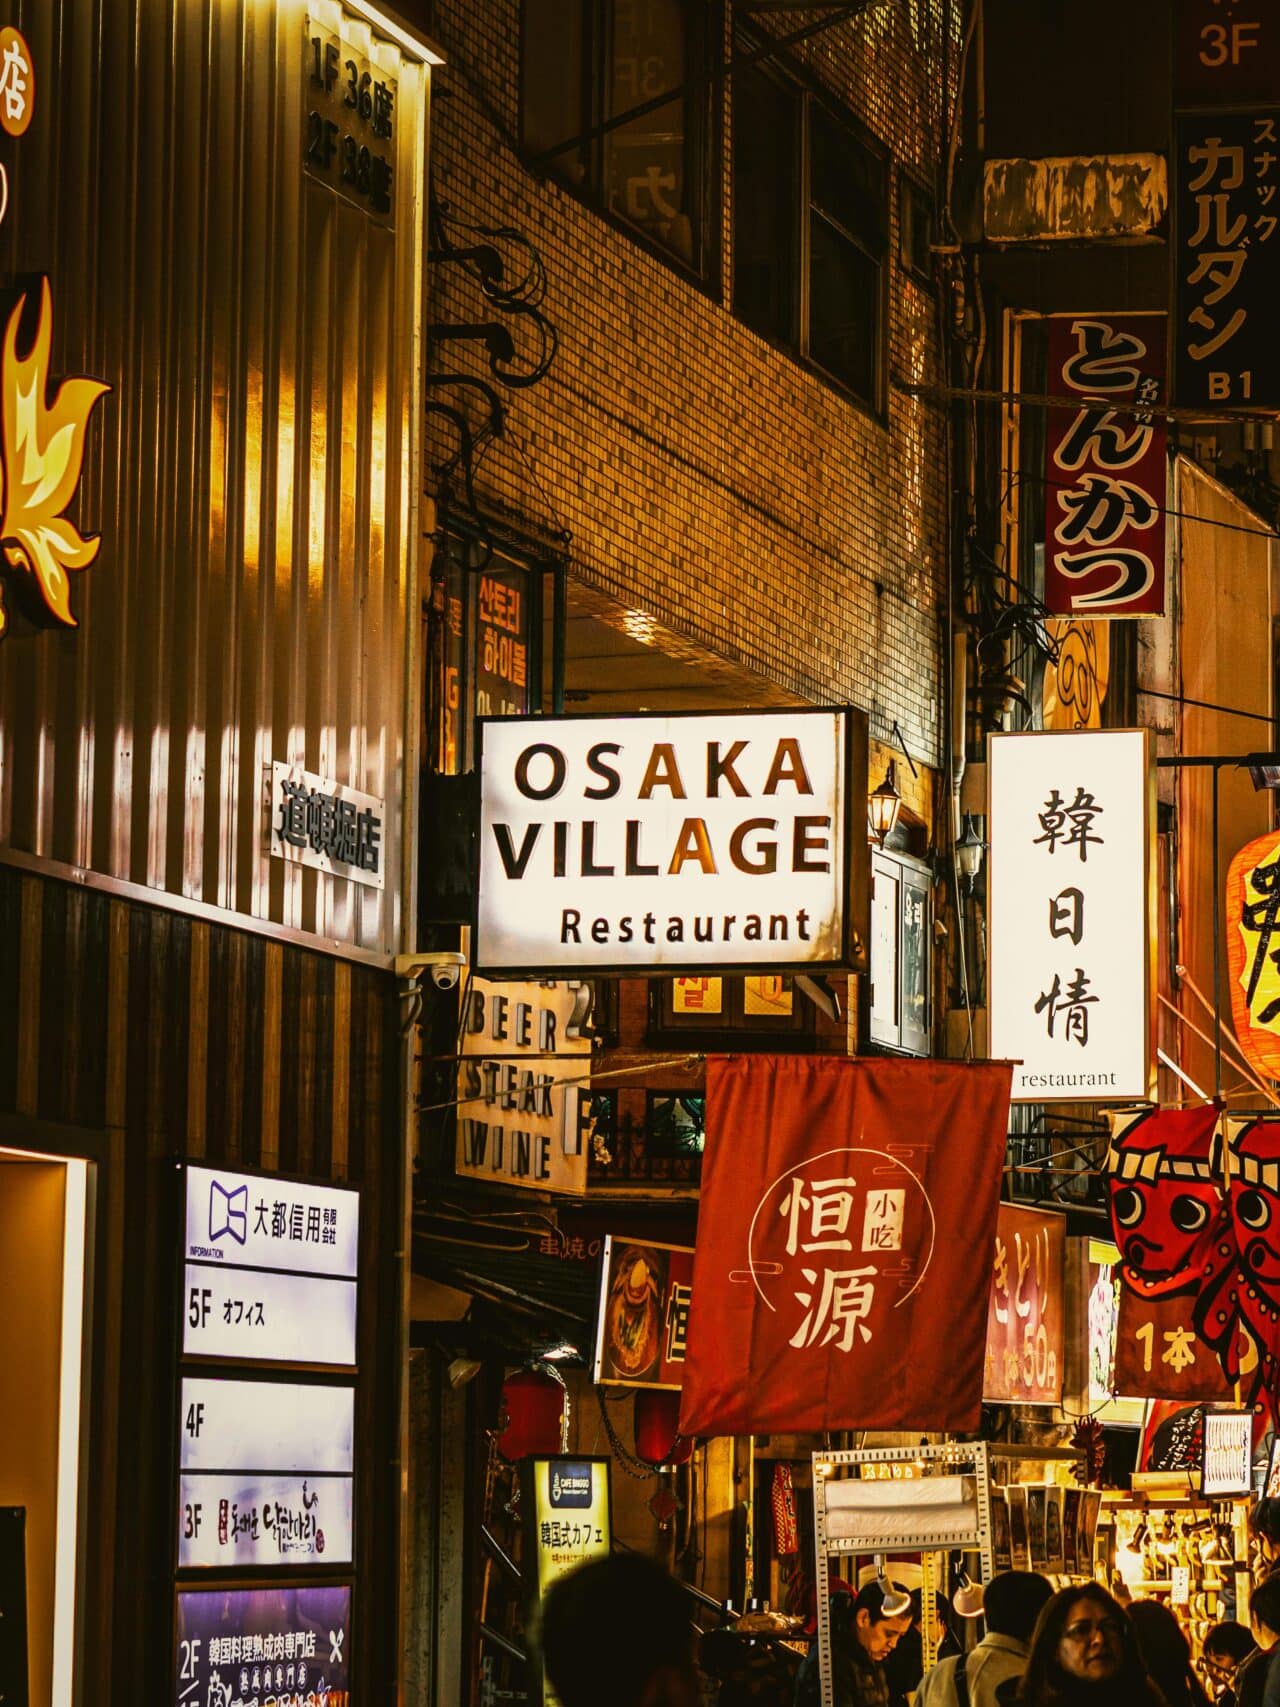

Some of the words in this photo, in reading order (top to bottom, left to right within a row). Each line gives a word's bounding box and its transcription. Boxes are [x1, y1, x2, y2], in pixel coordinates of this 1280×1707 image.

[1199, 23, 1260, 67] 3F
[1253, 118, 1278, 242] スナック
[1187, 137, 1252, 361] カルダン
[1208, 371, 1252, 401] B1
[1053, 320, 1158, 609] とんかつ
[514, 737, 814, 801] OSAKA
[491, 815, 831, 881] VILLAGE
[560, 908, 811, 945] Restaurant
[1032, 786, 1105, 1048] 韓日情
[467, 990, 557, 1053] BEER
[465, 1059, 555, 1117] STEAK
[1021, 1071, 1117, 1089] restaurant
[463, 1118, 551, 1180] WINE
[253, 1198, 321, 1244] 大都信用
[870, 1193, 897, 1249] 小吃
[189, 1246, 225, 1260] INFORMATION
[779, 1176, 879, 1354] 恒源
[189, 1288, 212, 1328] 5F
[223, 1299, 265, 1326] オフィス
[186, 1403, 204, 1438] 4F
[184, 1504, 202, 1539] 3F
[541, 1520, 603, 1549] 韓国式カフェ
[180, 1640, 202, 1680] 2F
[208, 1631, 316, 1667] 韓国料理熟成肉専門店
